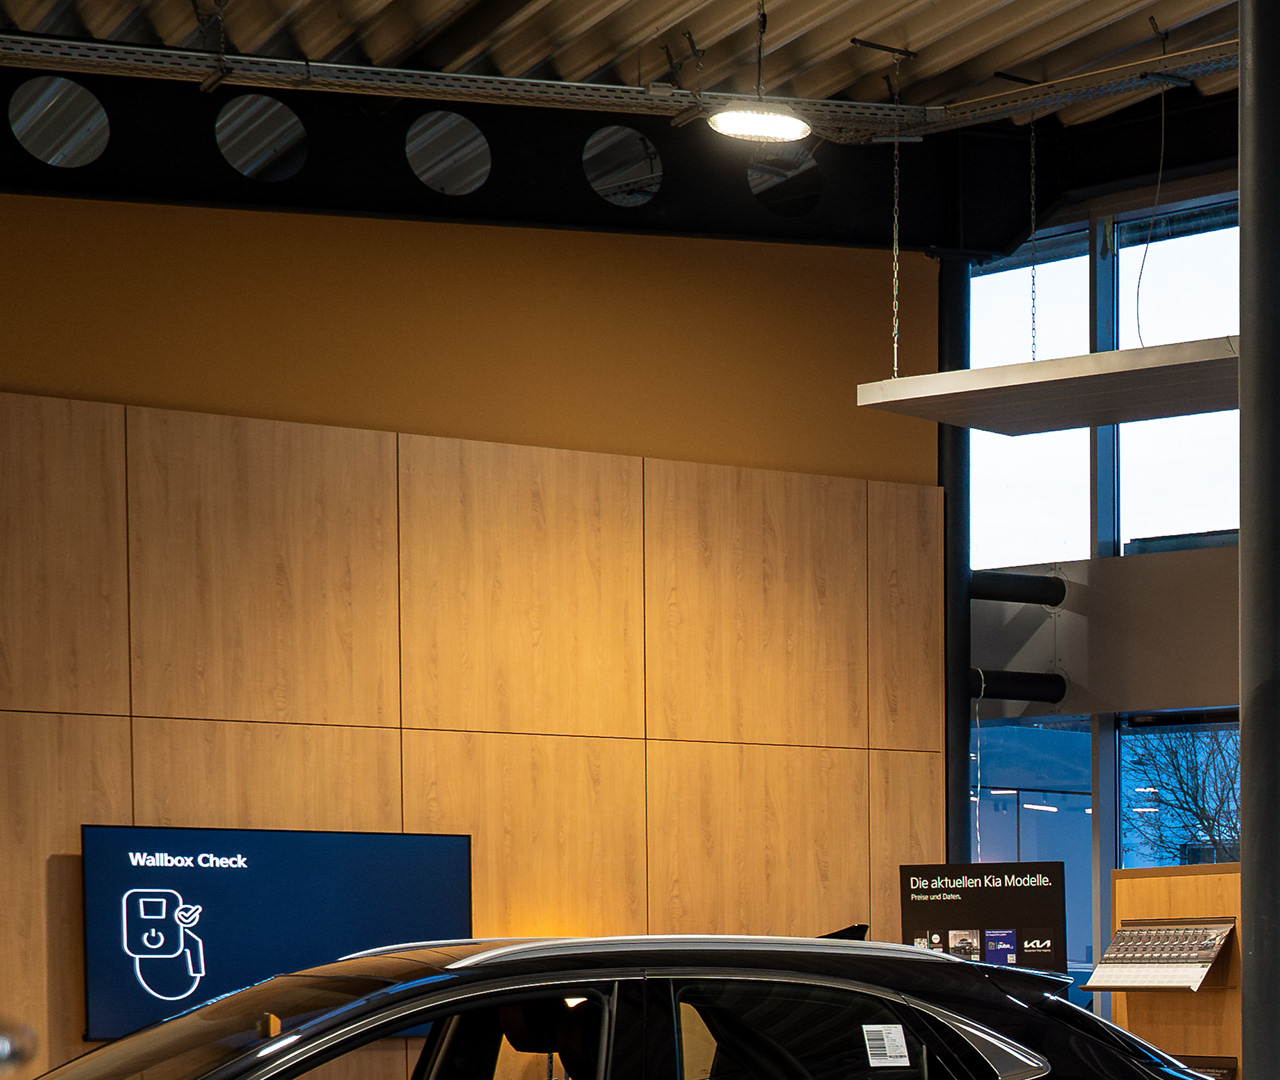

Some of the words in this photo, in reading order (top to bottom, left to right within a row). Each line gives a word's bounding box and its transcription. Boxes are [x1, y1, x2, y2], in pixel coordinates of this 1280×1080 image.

[128, 852, 195, 867] Wallbox
[197, 853, 248, 868] Check
[910, 877, 929, 889] Die
[931, 876, 982, 888] aktuellen
[984, 875, 1002, 887] Kia
[1004, 874, 1052, 887] Modelle.
